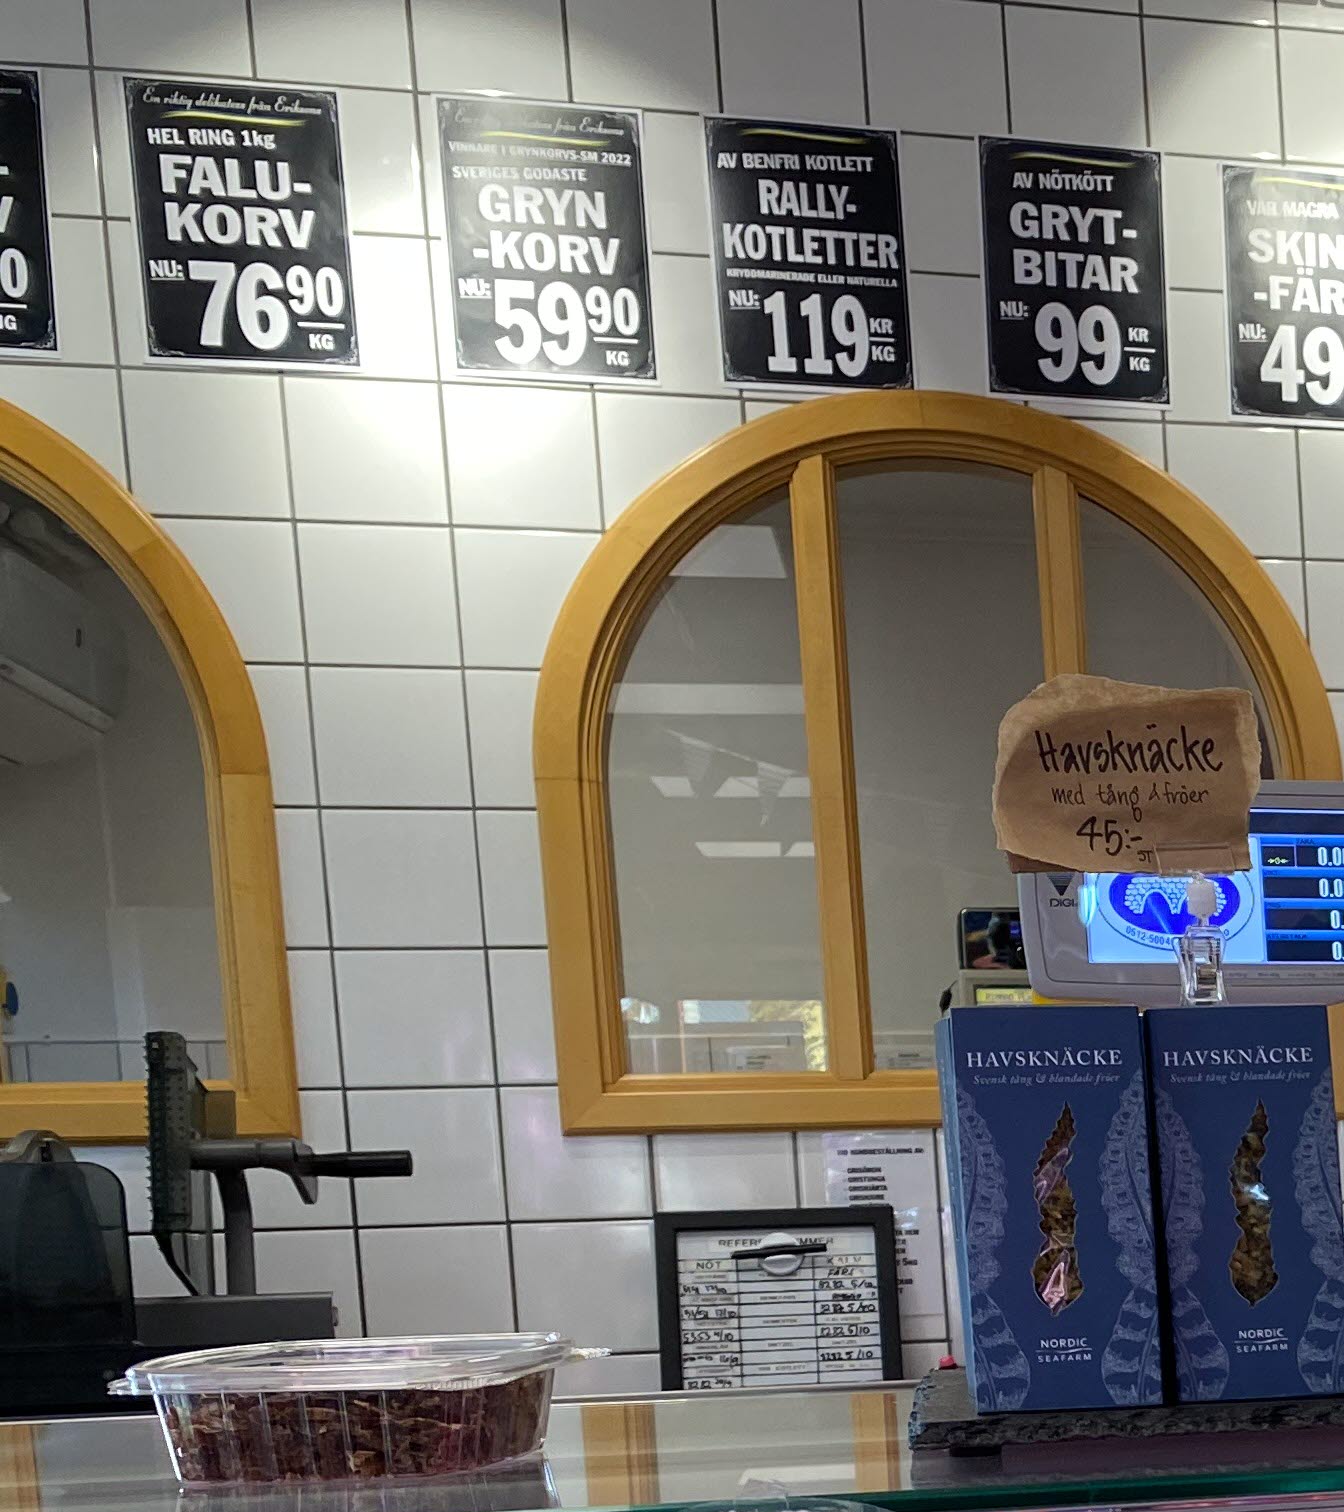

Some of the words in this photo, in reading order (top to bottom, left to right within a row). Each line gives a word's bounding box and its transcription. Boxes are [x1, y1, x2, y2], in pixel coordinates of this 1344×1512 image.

[147, 128, 185, 145] HEL
[188, 129, 236, 146] RING
[241, 130, 276, 149] 1kg
[717, 153, 737, 169] AV
[742, 154, 800, 171] BENFRI
[806, 156, 874, 173] KOTLETT
[158, 153, 312, 201] FALU-
[452, 167, 519, 180] SVERIGES
[523, 168, 587, 182] GODASTE
[1012, 173, 1033, 189] AV
[1039, 169, 1114, 192] NÖTKÖTT
[478, 184, 608, 229] GRYN
[758, 179, 857, 220] RALLY-
[164, 202, 316, 249] KORV
[1009, 201, 1137, 245] GRYT-
[473, 230, 620, 275] -KORV
[723, 223, 899, 269] KOTLETTER
[1013, 249, 1139, 294] BITAR
[763, 291, 870, 378] 119
[1034, 302, 1122, 386] 99
[1127, 327, 1149, 343] KR
[1129, 356, 1150, 372] KG
[1034, 723, 1224, 774] Havsknäcke
[1051, 784, 1084, 806] med
[1049, 898, 1075, 908] DIGI
[966, 1046, 1124, 1068] HAVSKNÄCKE
[1163, 1045, 1314, 1067] HAVSKNÄCKE
[1040, 1337, 1089, 1348] NORDIC
[1238, 1327, 1285, 1339] NORDIC
[1038, 1353, 1092, 1362] SEAFARM
